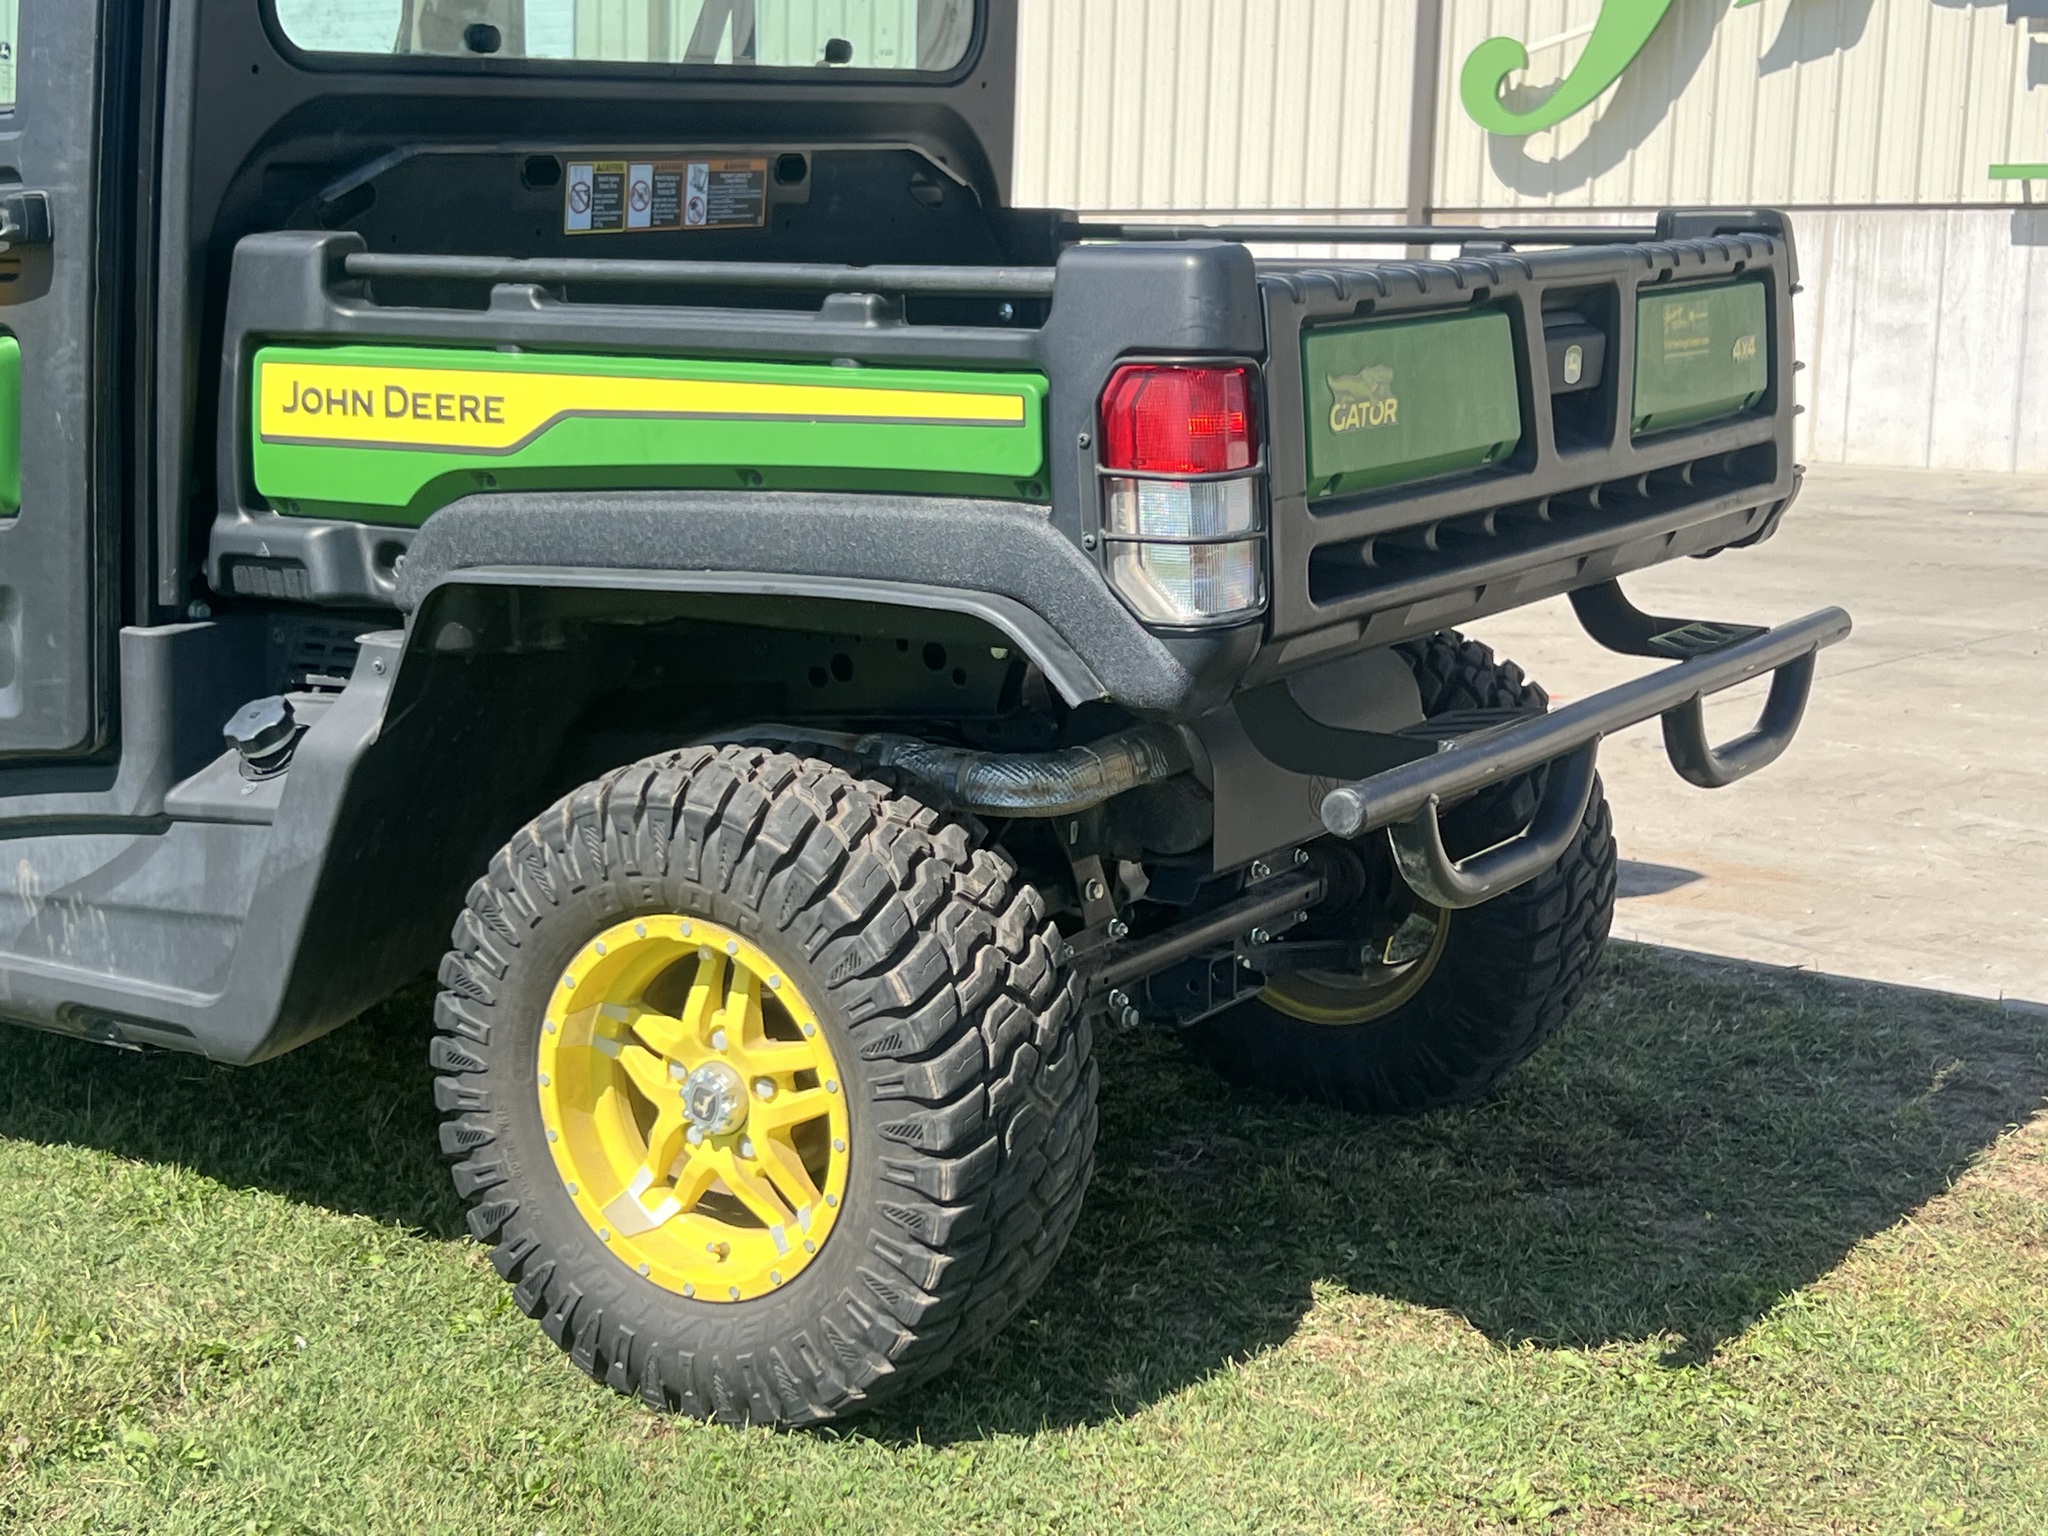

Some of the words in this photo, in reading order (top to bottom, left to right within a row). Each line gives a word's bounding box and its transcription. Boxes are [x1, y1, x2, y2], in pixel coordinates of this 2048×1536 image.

[282, 380, 374, 417] JOHN
[384, 384, 505, 424] DEERE
[1329, 398, 1398, 432] GATOR
